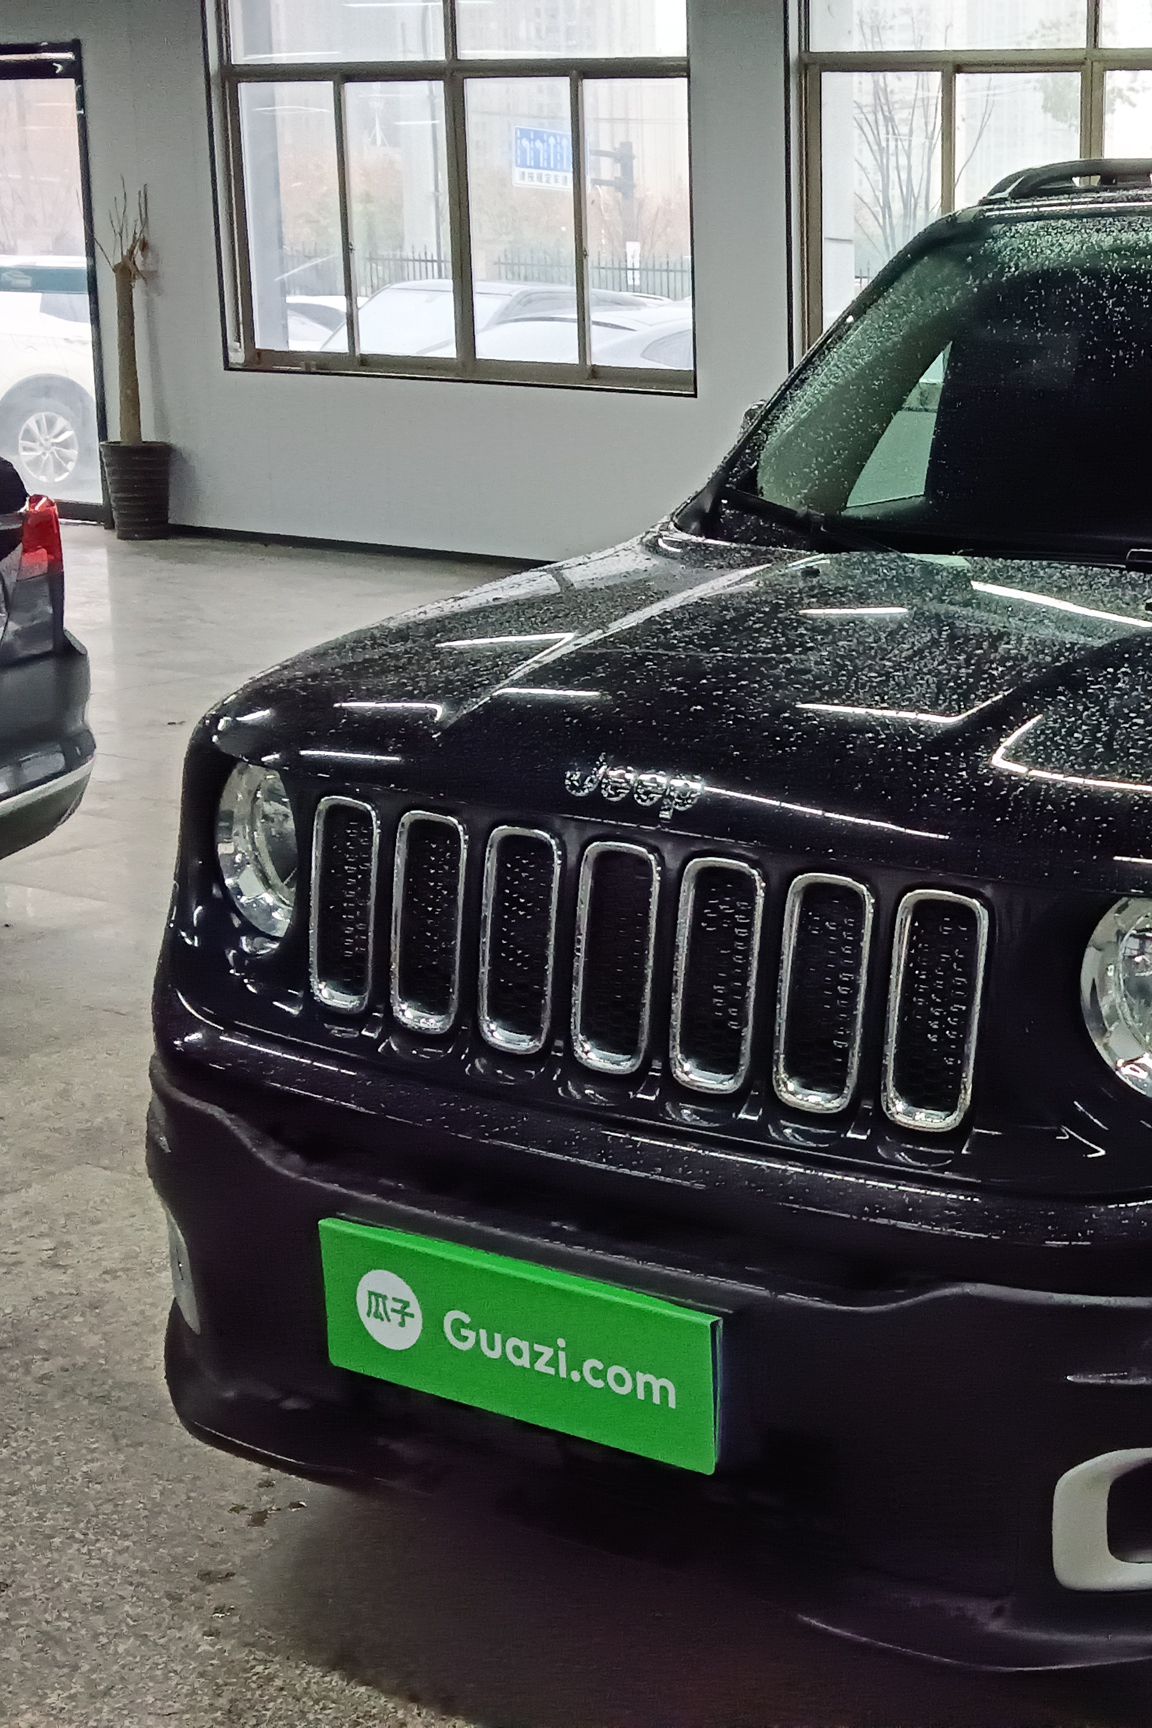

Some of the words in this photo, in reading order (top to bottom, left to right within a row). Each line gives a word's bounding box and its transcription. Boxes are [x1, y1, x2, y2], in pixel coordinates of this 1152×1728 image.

[564, 754, 704, 823] Jeep
[366, 1289, 415, 1328] 瓜子
[443, 1310, 677, 1409] Guazi.com
